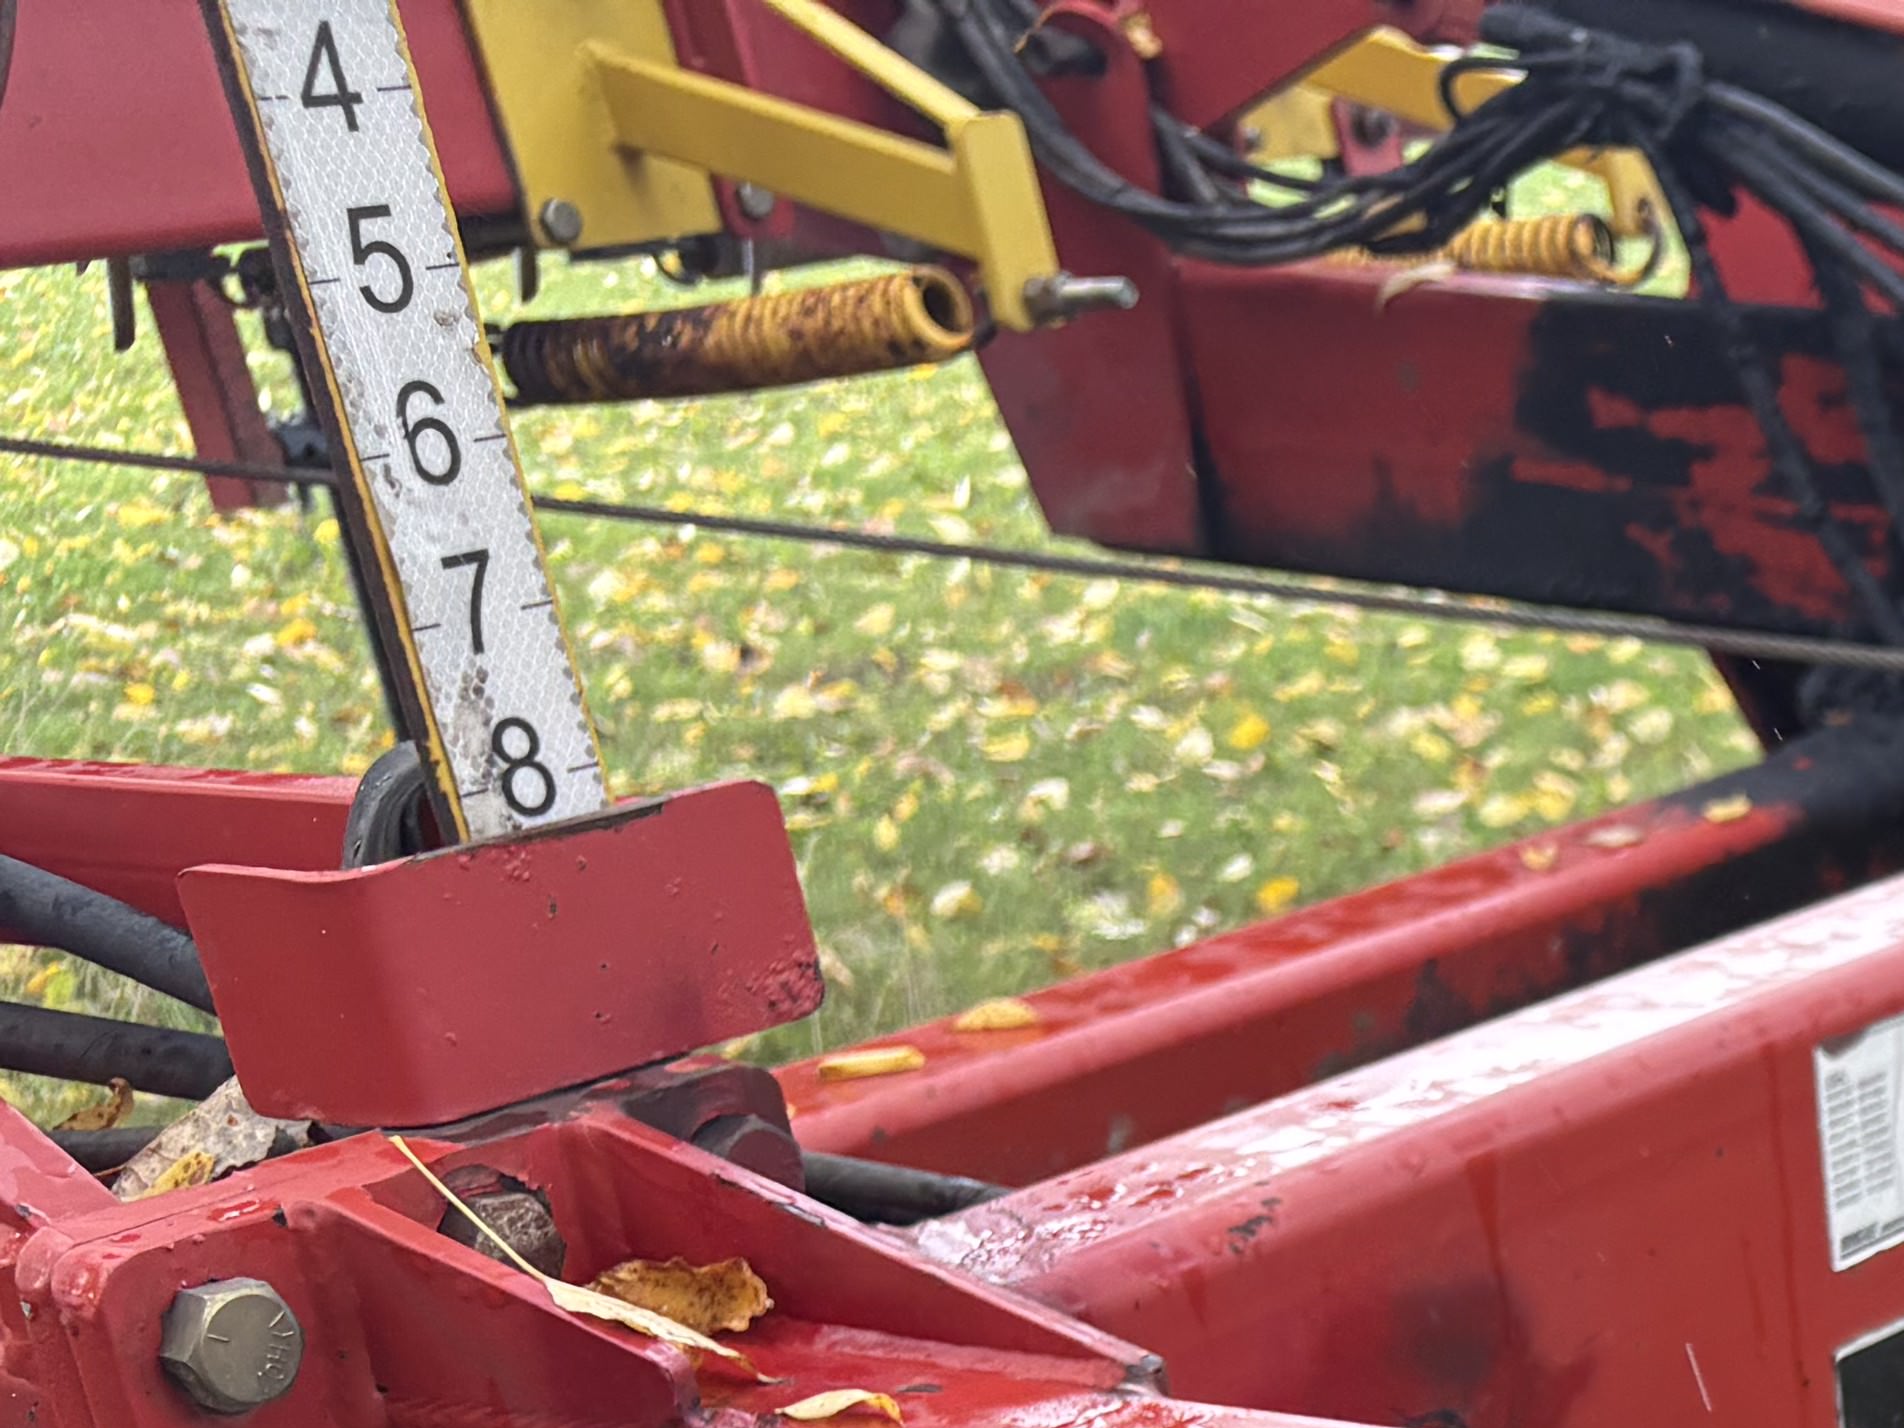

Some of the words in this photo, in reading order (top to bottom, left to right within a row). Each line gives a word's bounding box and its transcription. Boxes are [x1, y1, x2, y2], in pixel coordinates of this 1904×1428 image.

[299, 20, 362, 132] 4
[346, 204, 414, 314] 5
[398, 380, 461, 487] 6
[441, 548, 489, 655] 7
[491, 717, 556, 818] 8
